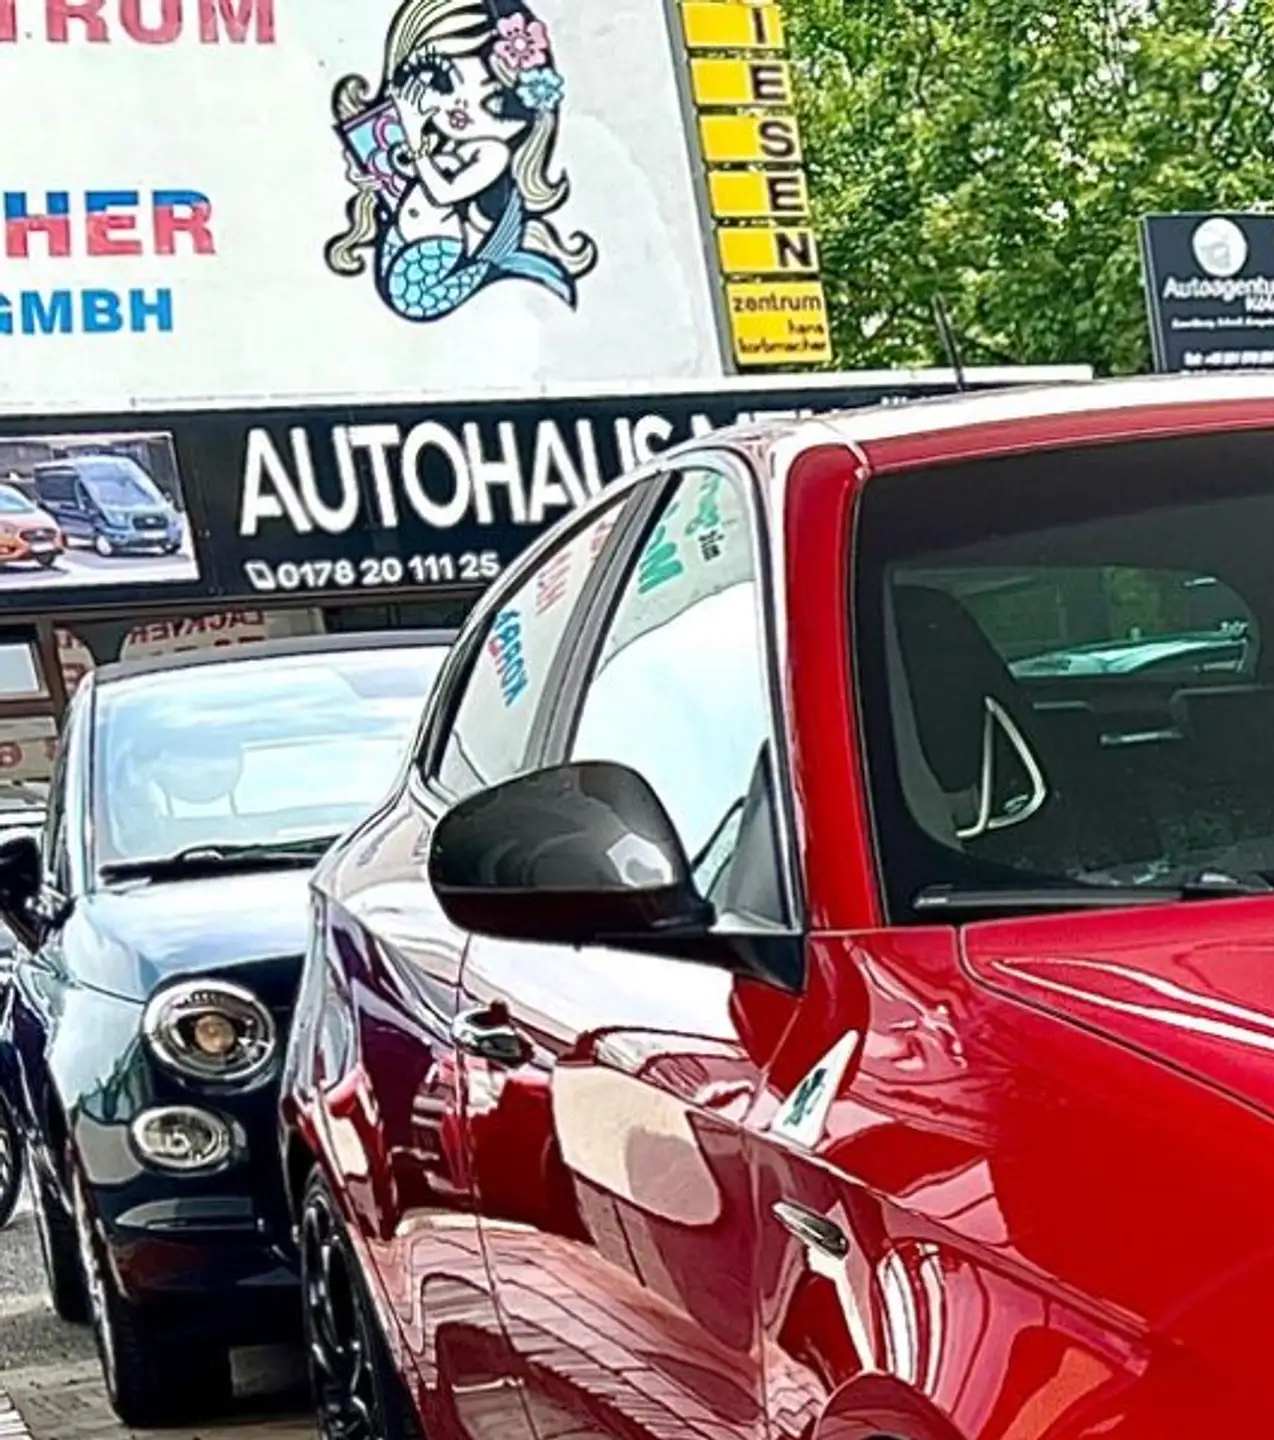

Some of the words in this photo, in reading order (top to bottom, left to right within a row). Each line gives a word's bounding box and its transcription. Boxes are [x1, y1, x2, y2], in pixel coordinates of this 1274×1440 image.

[0, 0, 276, 44] RUM
[0, 288, 173, 335] MBH
[732, 292, 822, 313] zentrum
[276, 558, 356, 590] 0178
[359, 557, 402, 585] 20
[458, 551, 501, 580] 25
